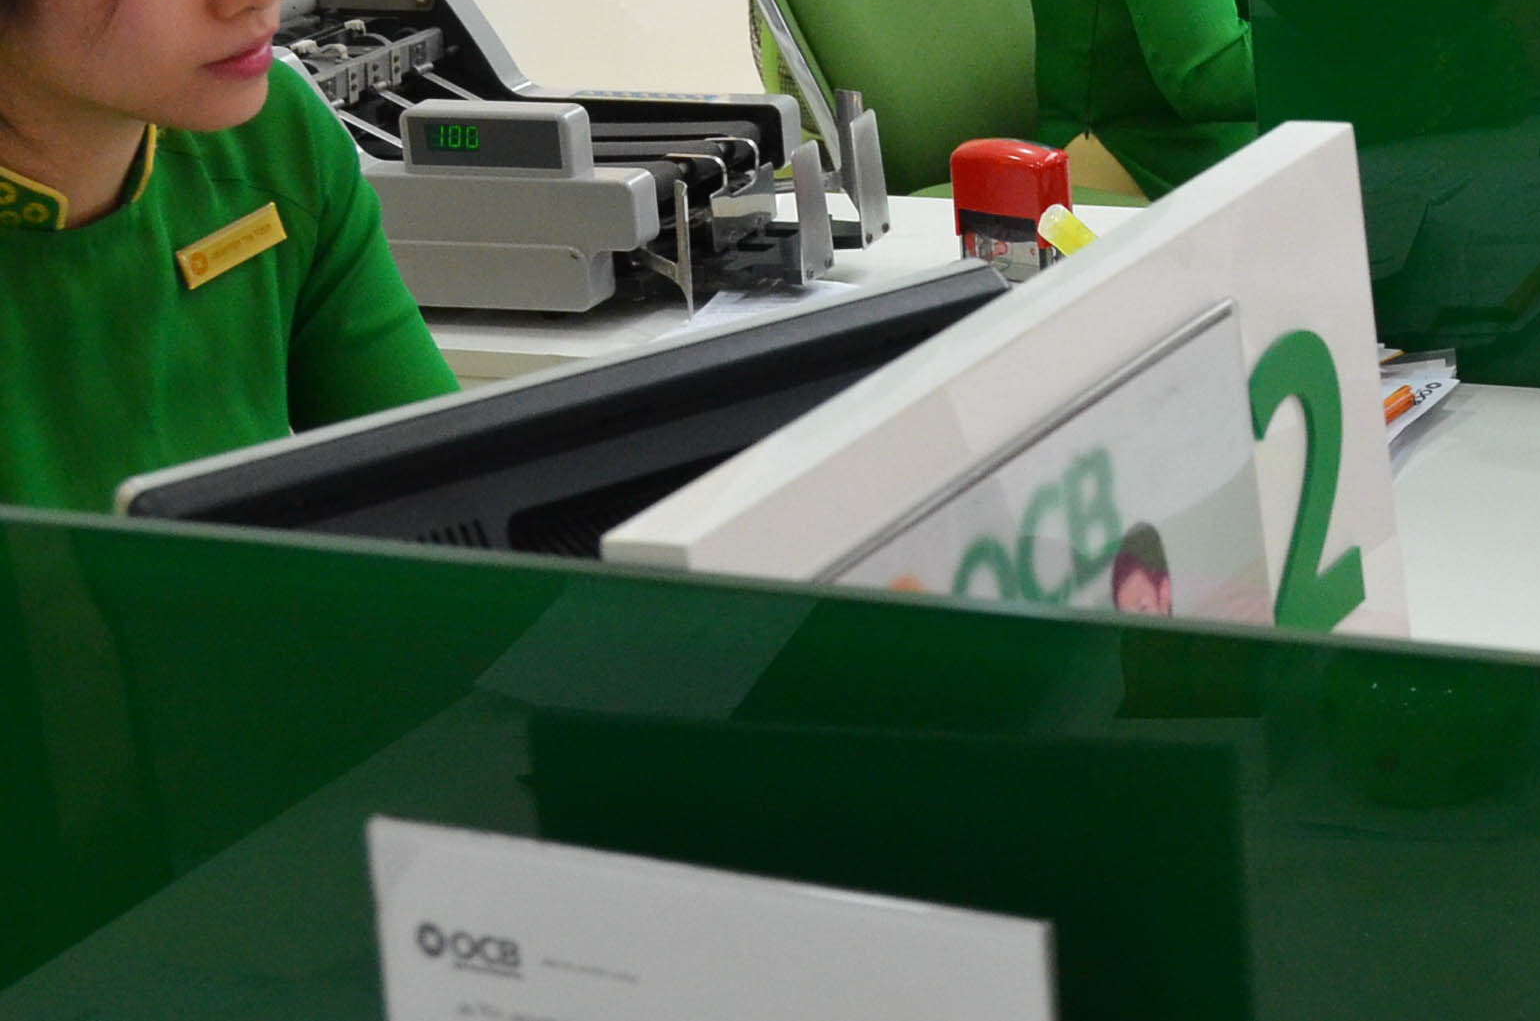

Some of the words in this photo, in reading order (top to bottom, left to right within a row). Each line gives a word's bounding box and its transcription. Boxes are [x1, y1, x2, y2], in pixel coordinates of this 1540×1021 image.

[438, 123, 480, 151] 100
[952, 444, 1124, 608] OCB
[1248, 329, 1366, 631] 2
[450, 931, 521, 969] OCB
